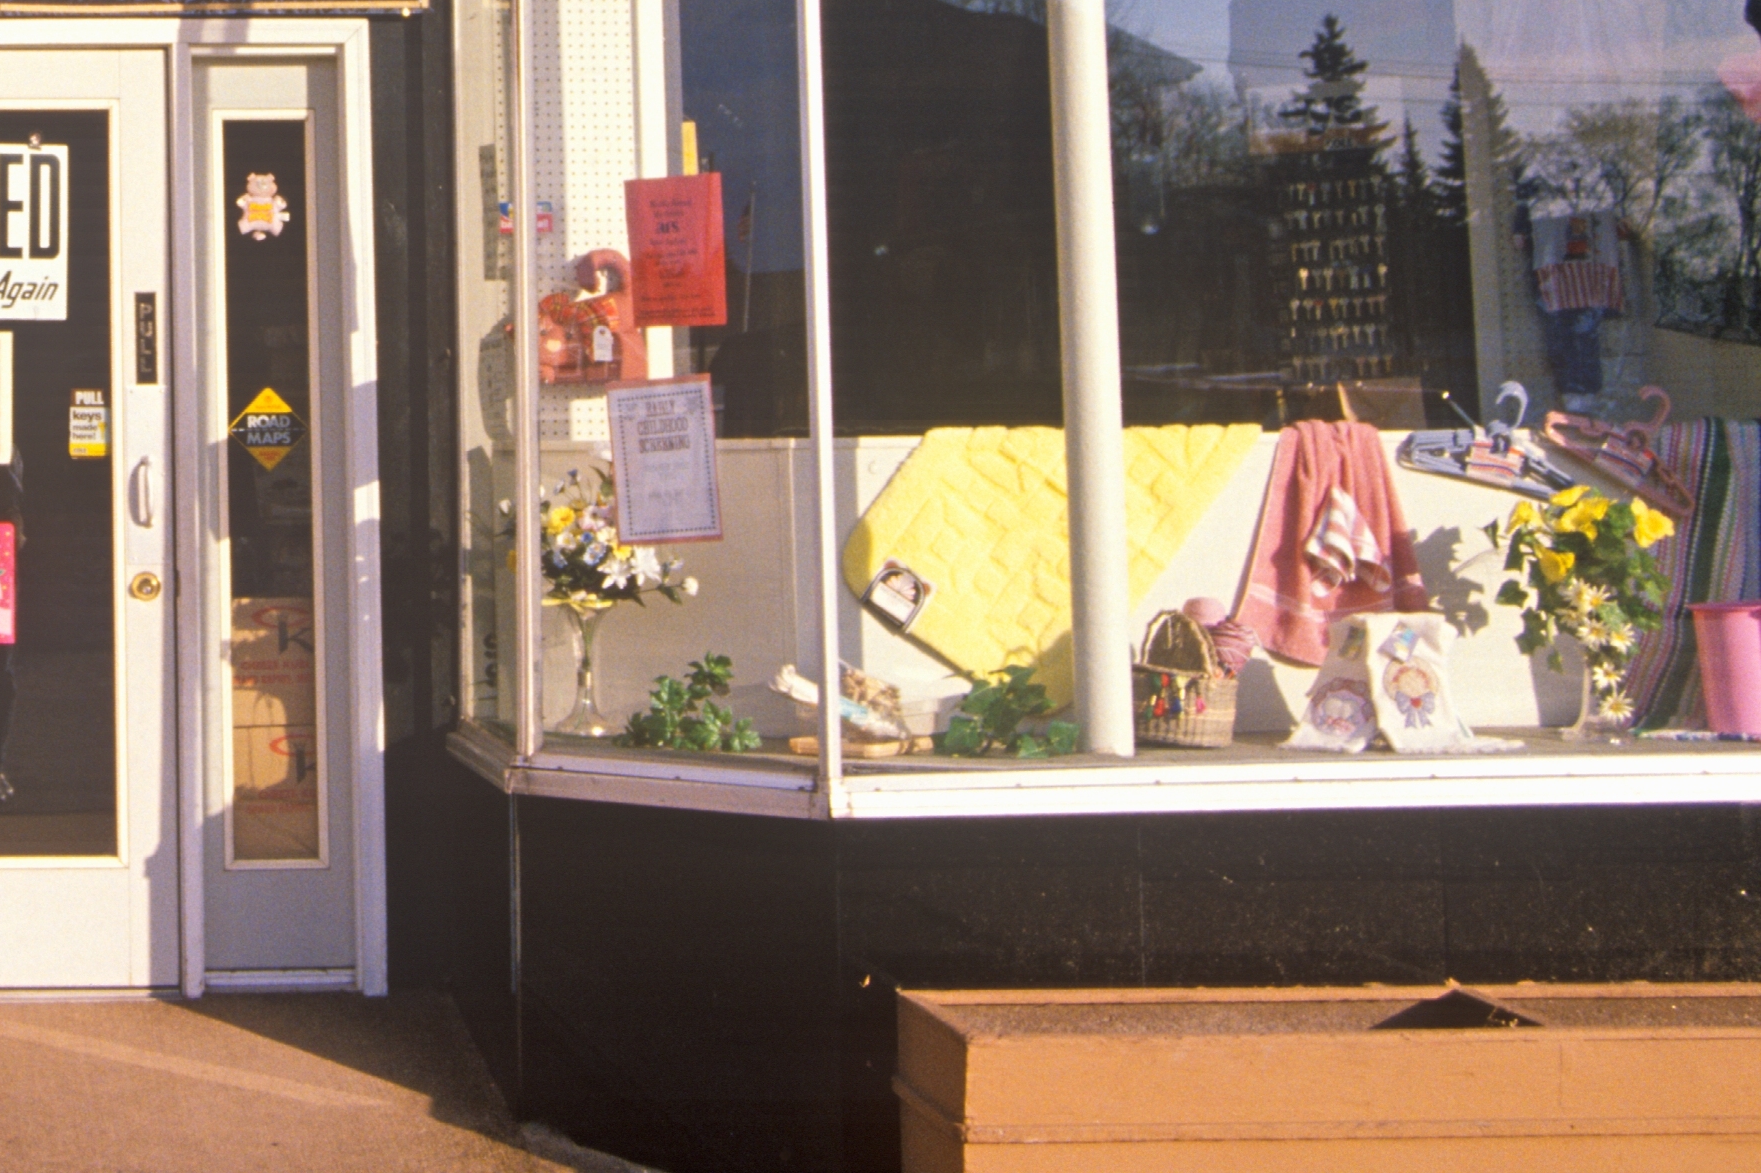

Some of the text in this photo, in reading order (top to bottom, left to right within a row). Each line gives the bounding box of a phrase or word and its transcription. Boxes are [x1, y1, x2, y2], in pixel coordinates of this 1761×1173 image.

[139, 302, 153, 373] PULL
[75, 390, 105, 405] PULL
[72, 409, 102, 423] keys
[247, 414, 291, 428] ROAD
[247, 431, 291, 445] MAPS
